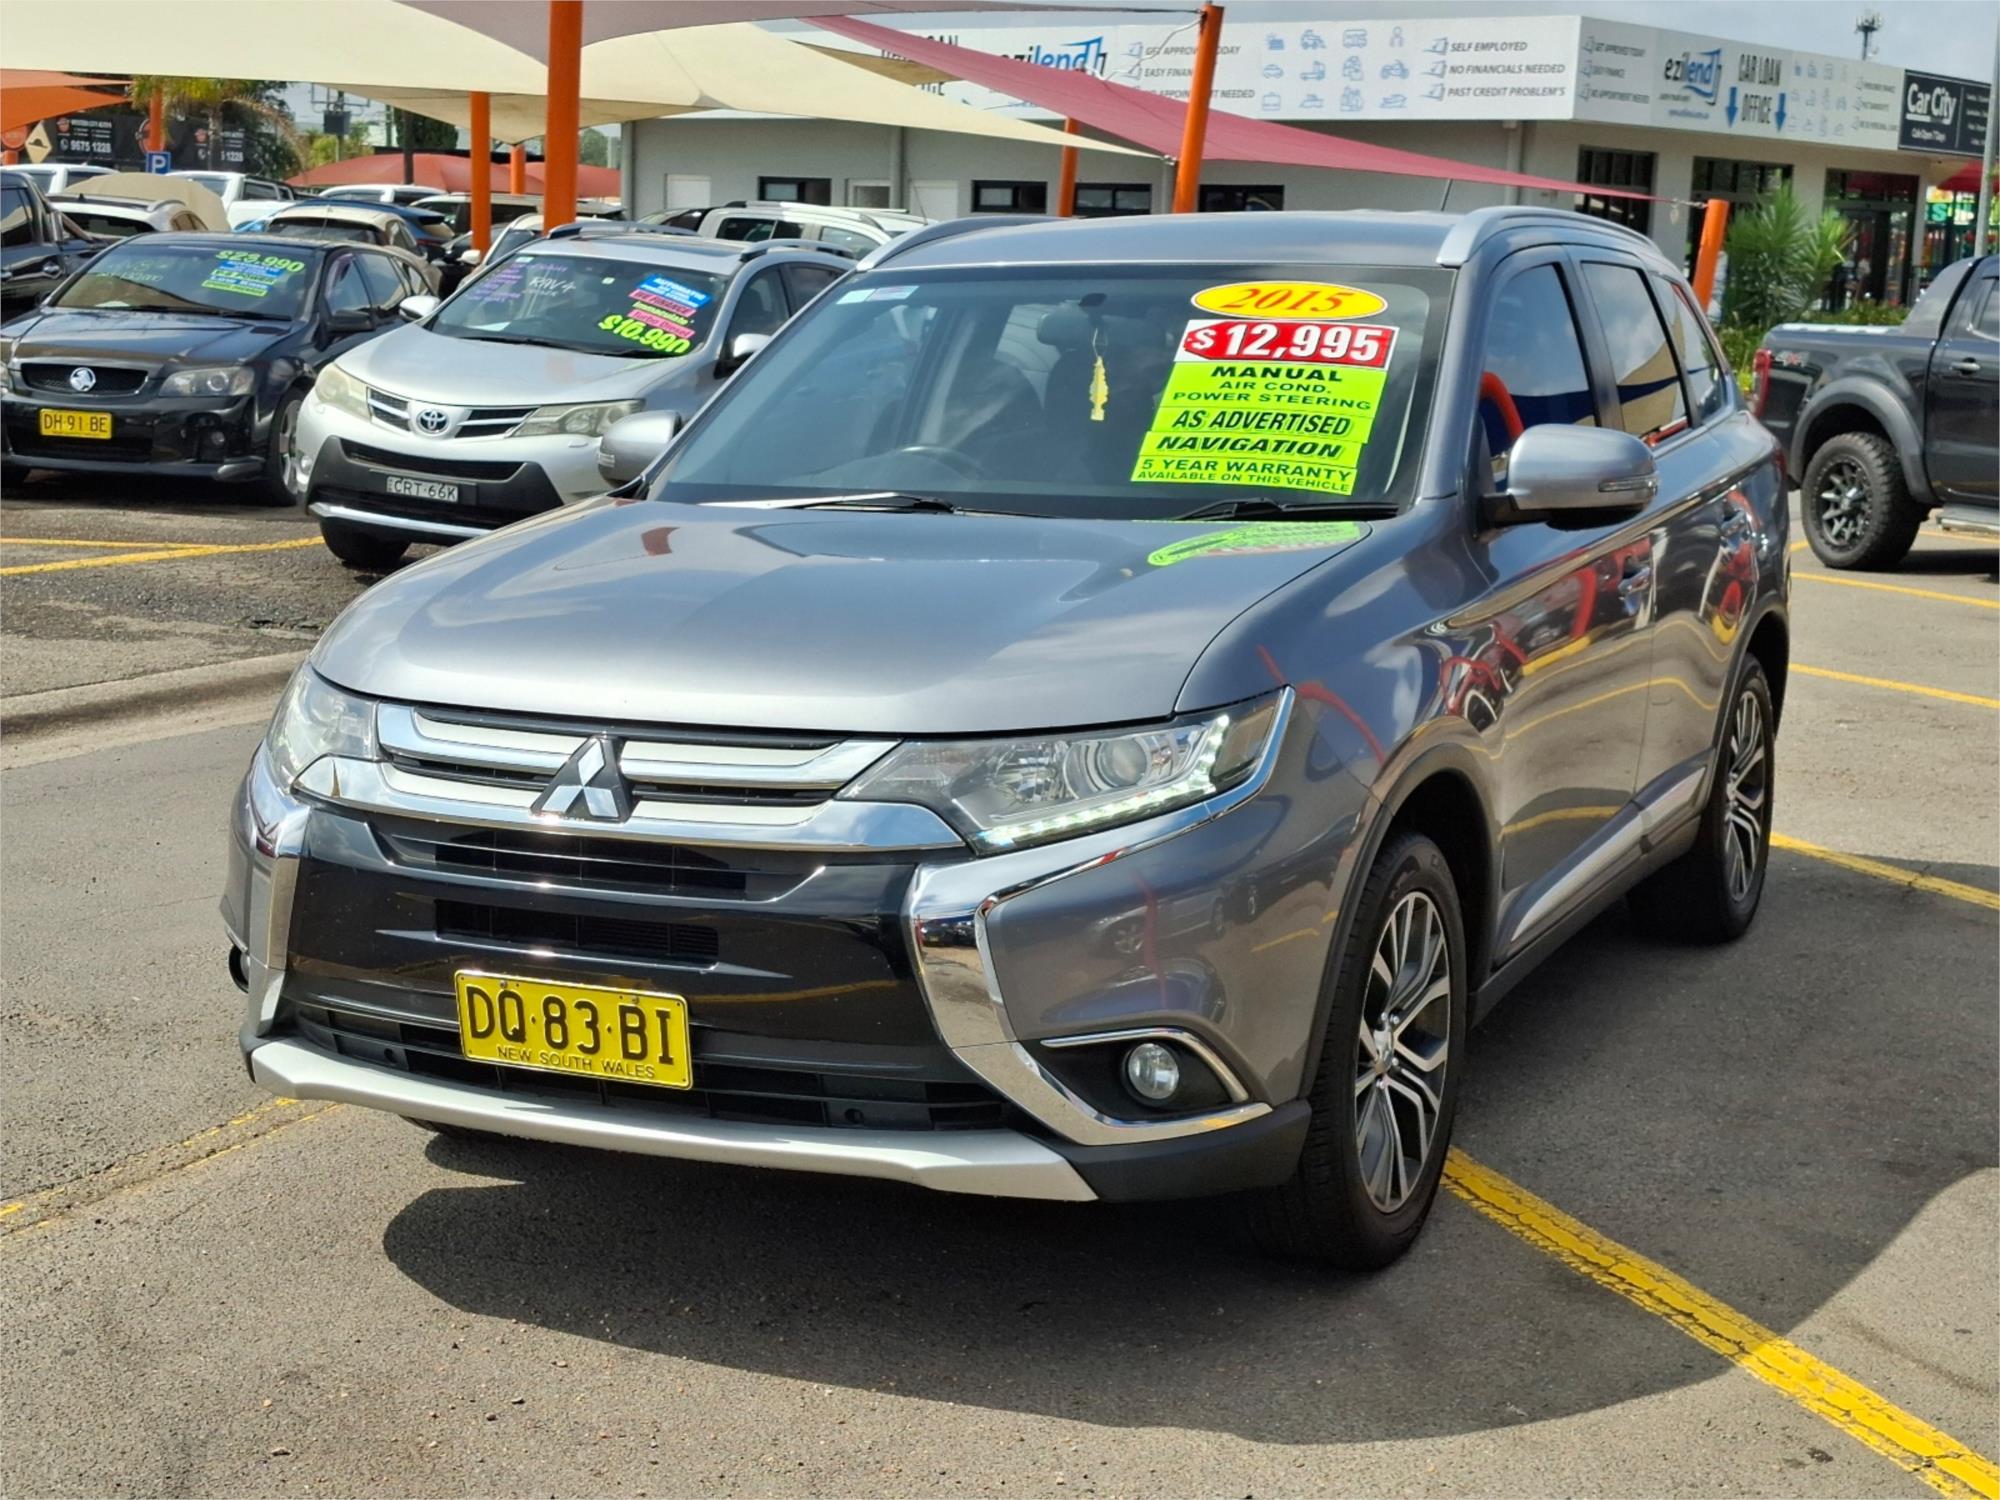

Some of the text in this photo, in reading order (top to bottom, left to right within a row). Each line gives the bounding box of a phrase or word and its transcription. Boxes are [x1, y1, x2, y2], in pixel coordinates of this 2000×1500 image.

[1450, 42, 1528, 52] SELF EMPLOYED
[1144, 67, 1167, 77] EASY
[1449, 64, 1566, 74] NO FINANCIALS NEEDED
[1739, 53, 1782, 86] CAR LOAN
[1221, 89, 1255, 99] NEEDED
[1447, 87, 1472, 97] PAST
[1473, 87, 1508, 97] CREDIT
[1741, 93, 1772, 125] OFFICE
[1907, 83, 1957, 125] Car City
[152, 154, 166, 174] P
[1221, 288, 1355, 312] 2015
[1211, 366, 1343, 382] MANUAL
[1219, 381, 1332, 394] AIR COND.
[1173, 392, 1372, 411] POWER STEERING
[1172, 410, 1353, 437] AS ADVERTISED
[1156, 436, 1343, 458] NAVIGATION
[1142, 459, 1353, 482] 5 YEAR WARRANTY
[1138, 472, 1351, 493] AVAILABLE ON THIS VEHICLE
[497, 1046, 656, 1079] NEW SOUTH WALES
